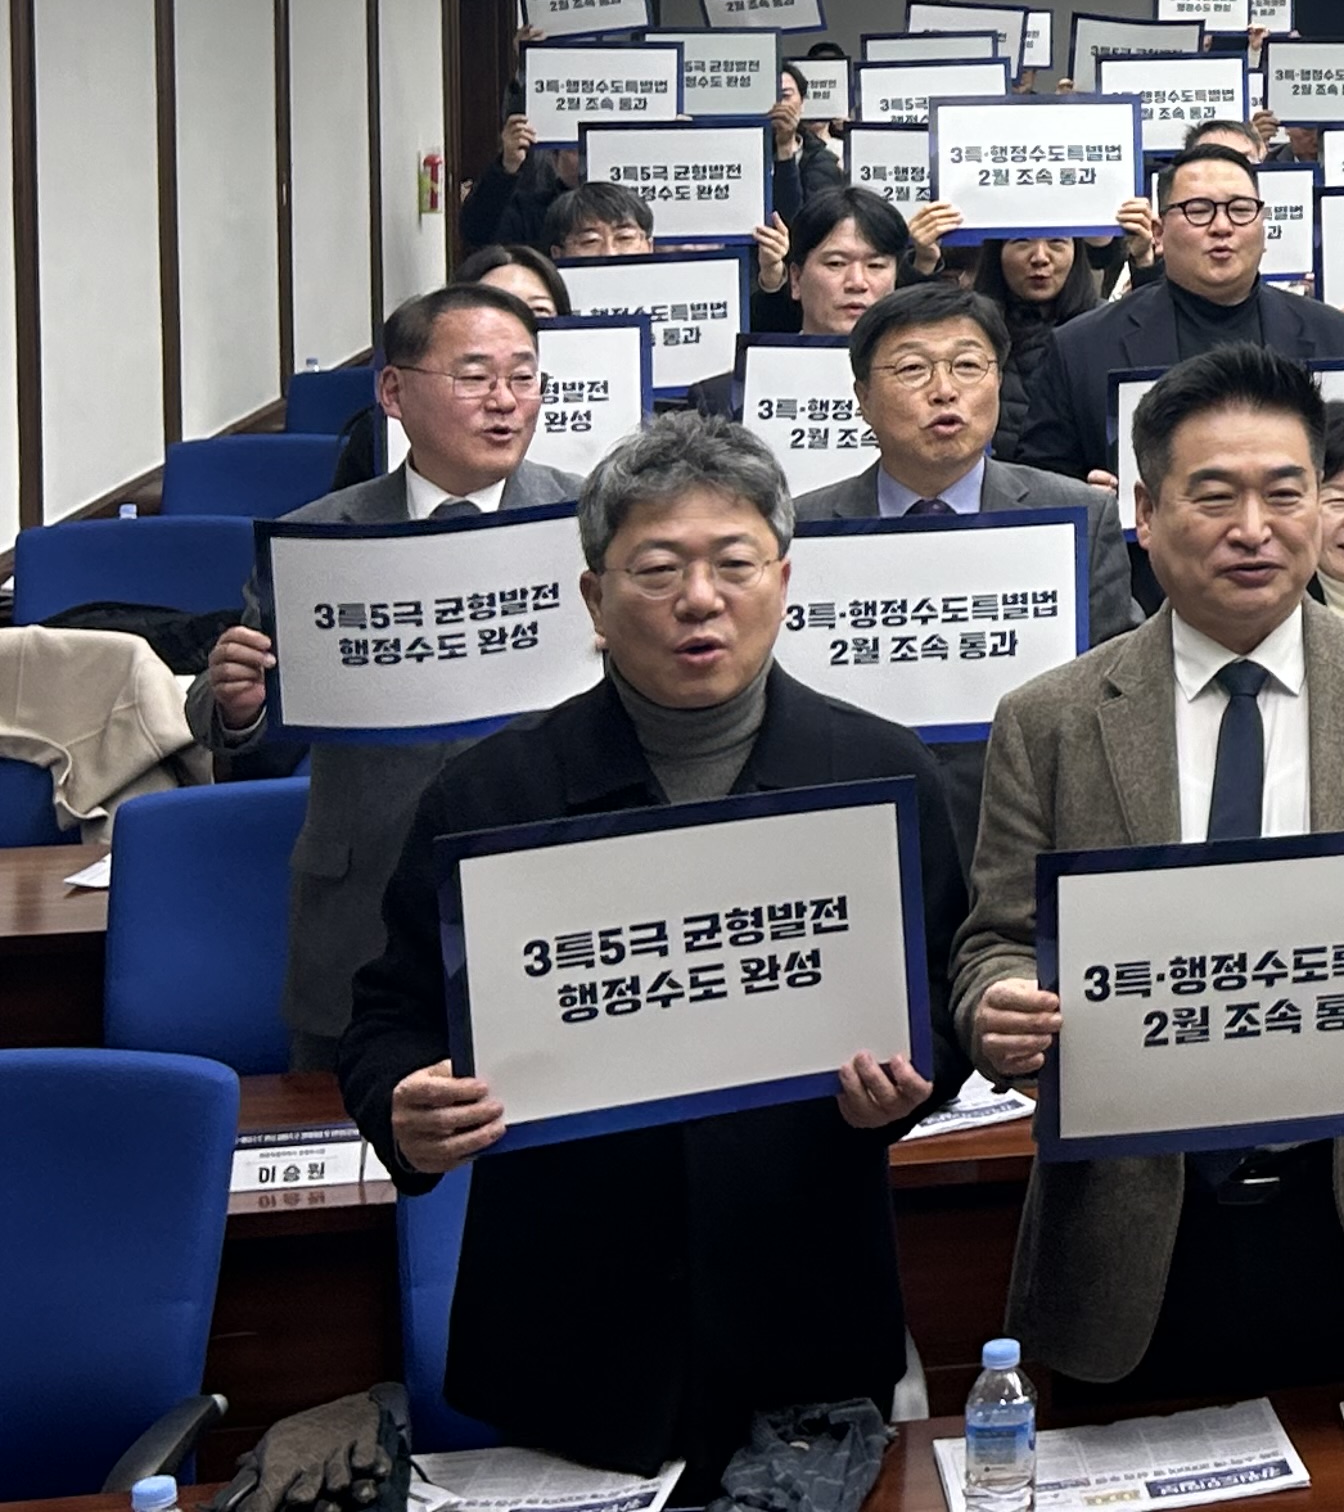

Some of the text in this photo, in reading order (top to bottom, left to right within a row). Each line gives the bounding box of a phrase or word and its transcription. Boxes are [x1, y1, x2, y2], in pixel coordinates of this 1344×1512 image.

[710, 60, 759, 72] 균형발전
[726, 76, 750, 87] 완성
[1292, 84, 1312, 95] 2월
[1316, 84, 1338, 95] 조속
[556, 97, 647, 111] 2월 조속 통과
[1159, 106, 1216, 120] 조속 통과
[951, 145, 1122, 163] 3특·행정수도특별법
[610, 164, 741, 181] 3특5극 균형발전
[979, 168, 1096, 186] 2월 조속 통과
[697, 184, 729, 200] 완성
[882, 187, 910, 202] 2월
[663, 327, 701, 346] 통과
[545, 410, 591, 433] 완성
[791, 428, 829, 449] 2월
[314, 582, 560, 630] 3특5극 균형발전
[339, 621, 538, 667] 행정수도 완성
[830, 630, 1018, 666] 2월 조속 통과
[524, 896, 849, 977] 3특5극 균형발전
[558, 948, 821, 1023] 행정수도 완성
[1144, 1006, 1209, 1047] 2월
[1224, 999, 1302, 1039] 조속
